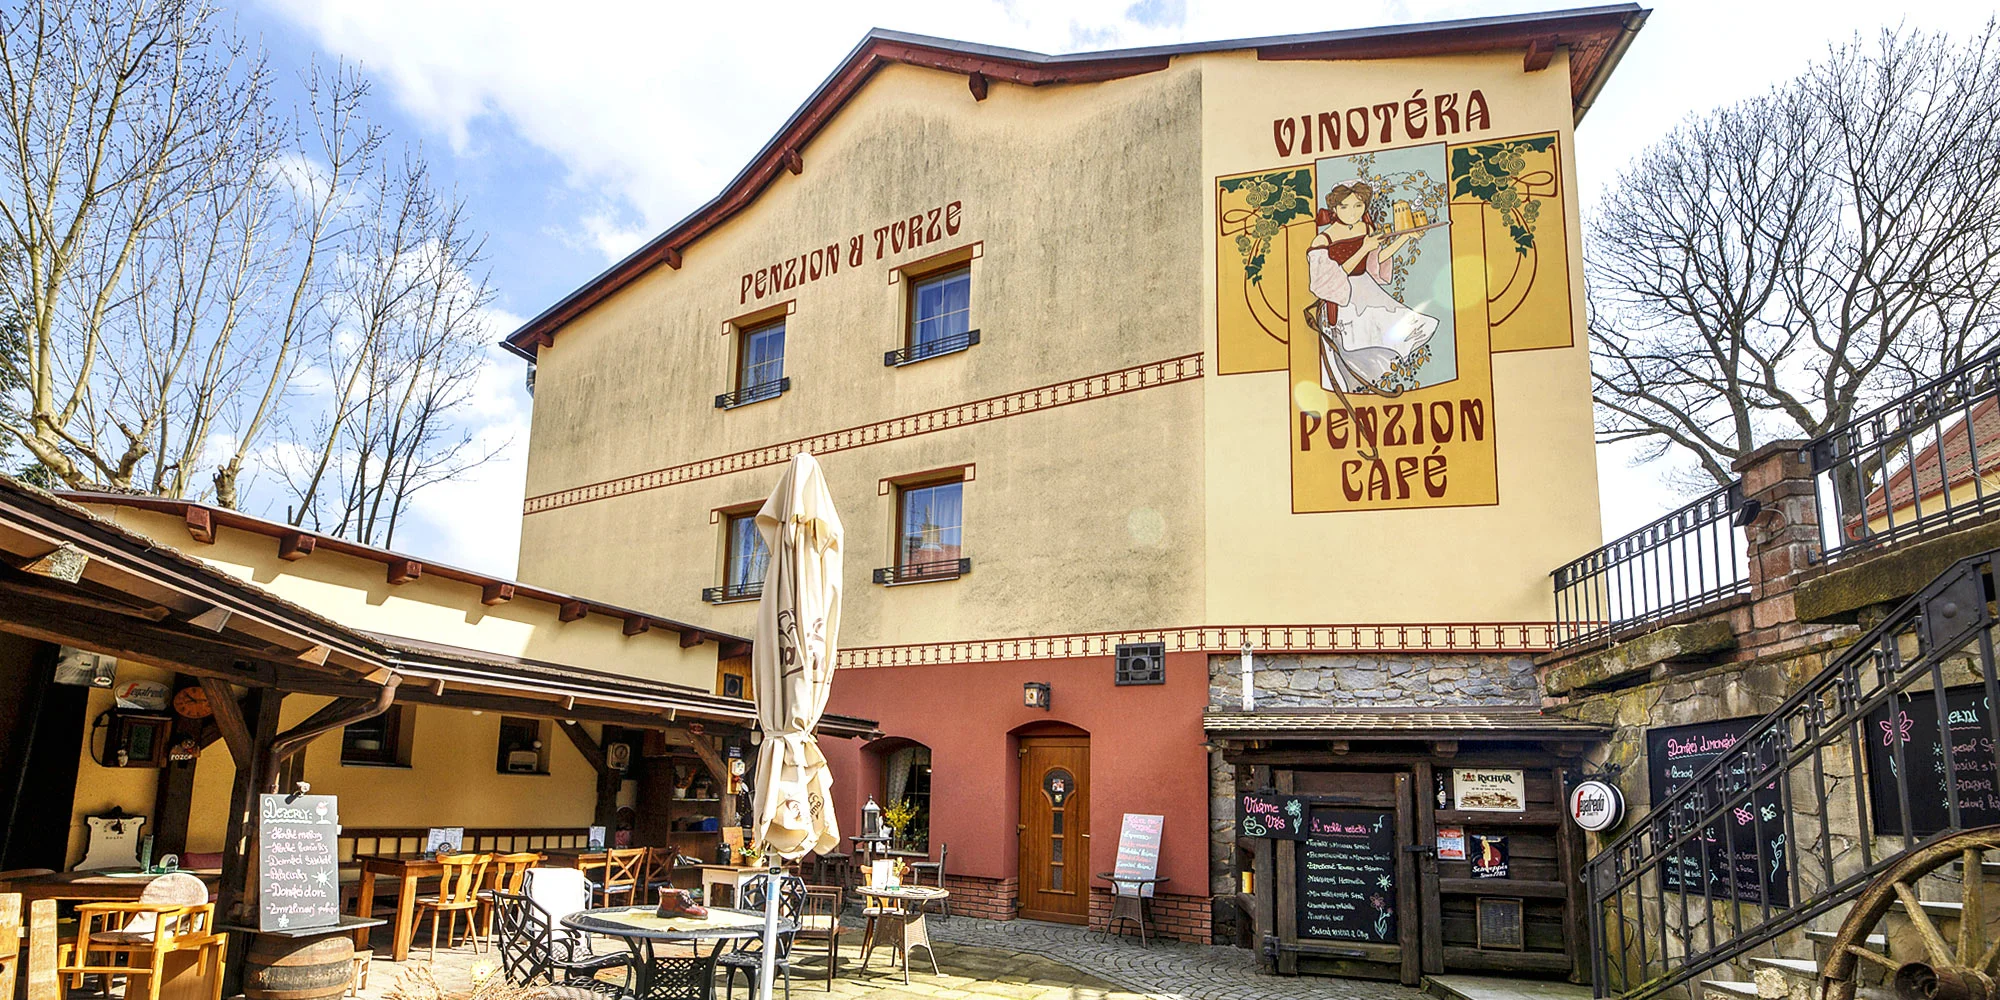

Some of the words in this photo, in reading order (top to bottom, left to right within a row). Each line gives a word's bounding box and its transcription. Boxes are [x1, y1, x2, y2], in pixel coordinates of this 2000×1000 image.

[1274, 89, 1491, 157] VINOTÉKA
[740, 243, 839, 304] PENZION
[874, 200, 962, 260] TVRZE
[1300, 398, 1484, 451] PENZION
[1342, 445, 1447, 501] CAFÉ
[1947, 701, 1979, 724] etní
[1960, 797, 1985, 810] edová
